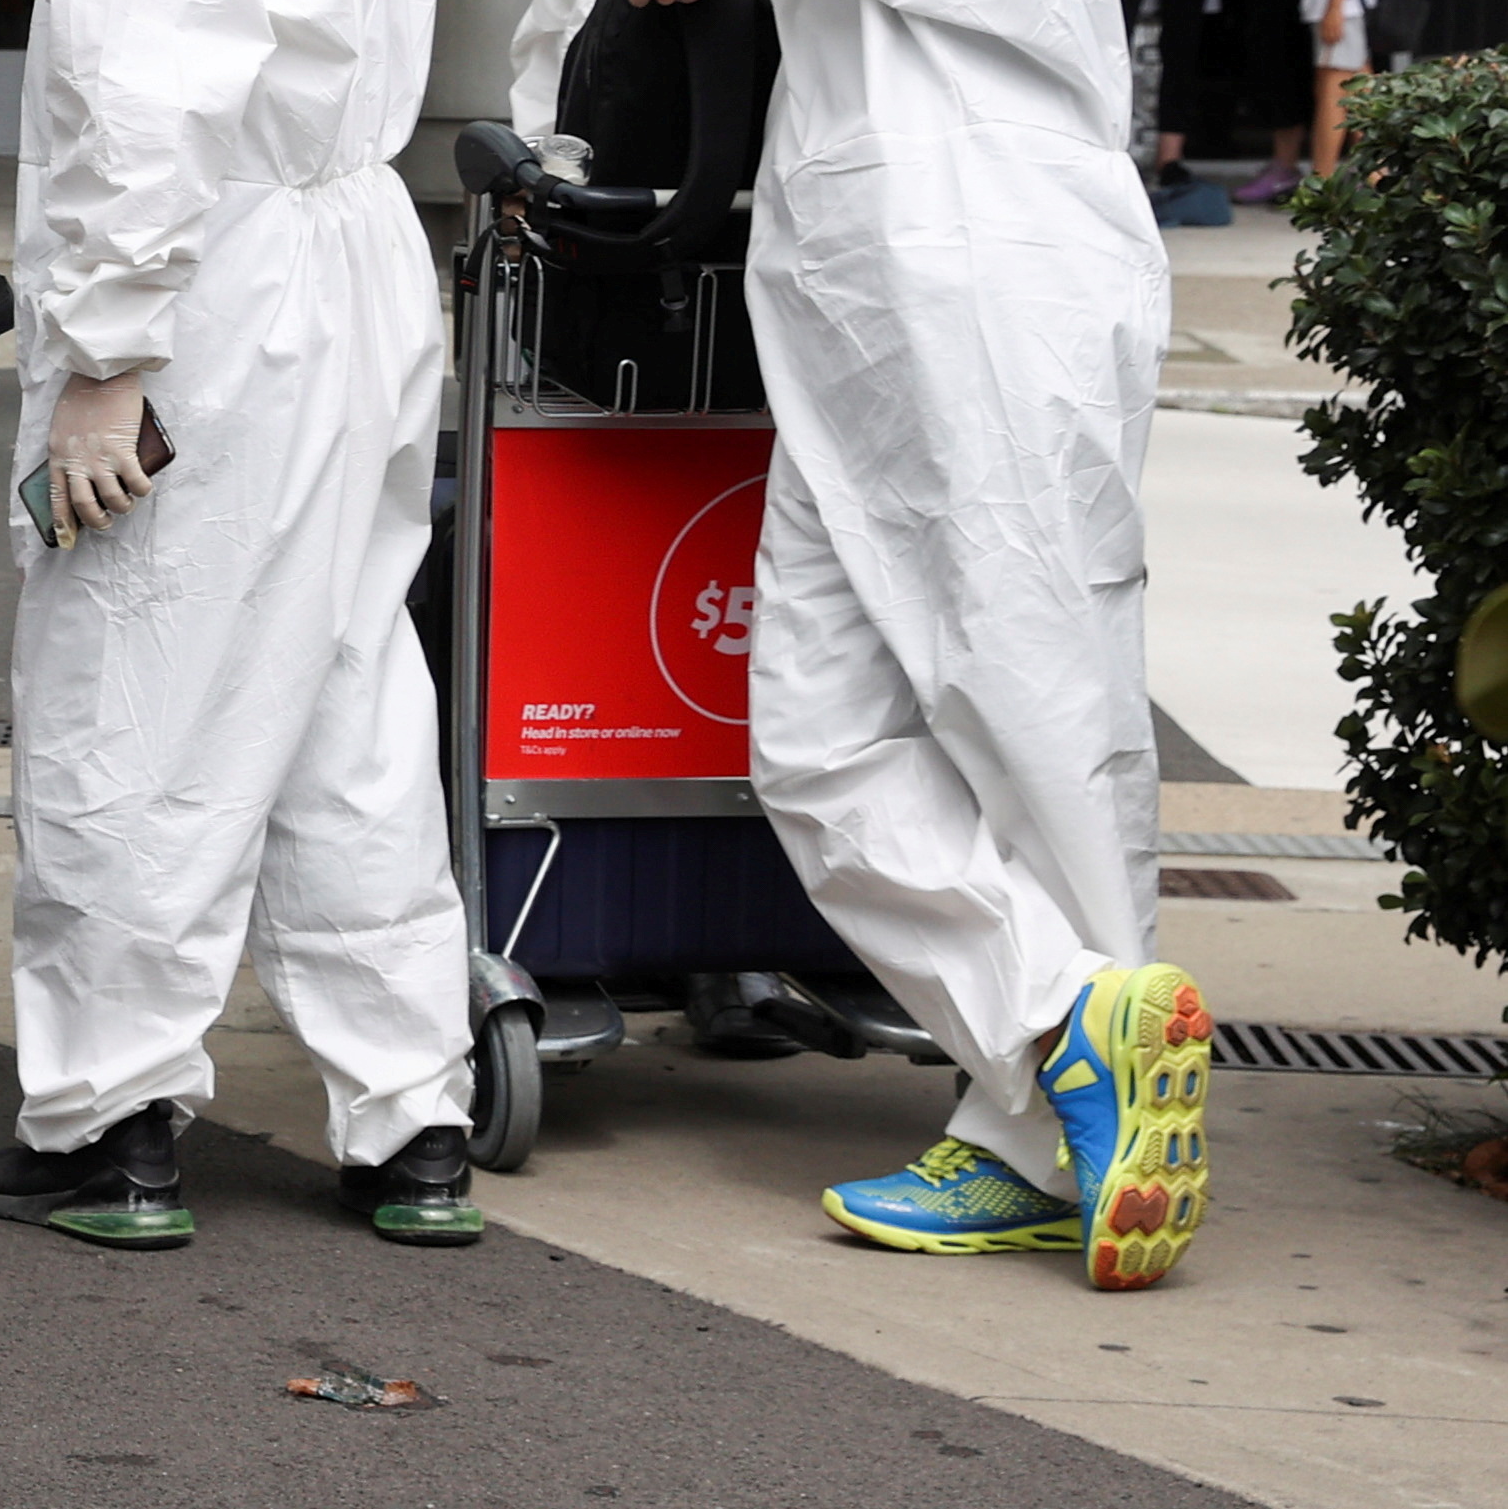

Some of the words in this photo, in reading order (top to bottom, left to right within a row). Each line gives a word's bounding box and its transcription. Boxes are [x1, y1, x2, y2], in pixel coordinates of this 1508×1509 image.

[690, 580, 754, 655] $5
[521, 703, 596, 721] READY?
[521, 726, 553, 739] Head
[555, 726, 567, 739] in
[568, 727, 600, 739] store
[601, 729, 614, 739] or
[615, 726, 654, 739] online
[655, 728, 682, 739] now
